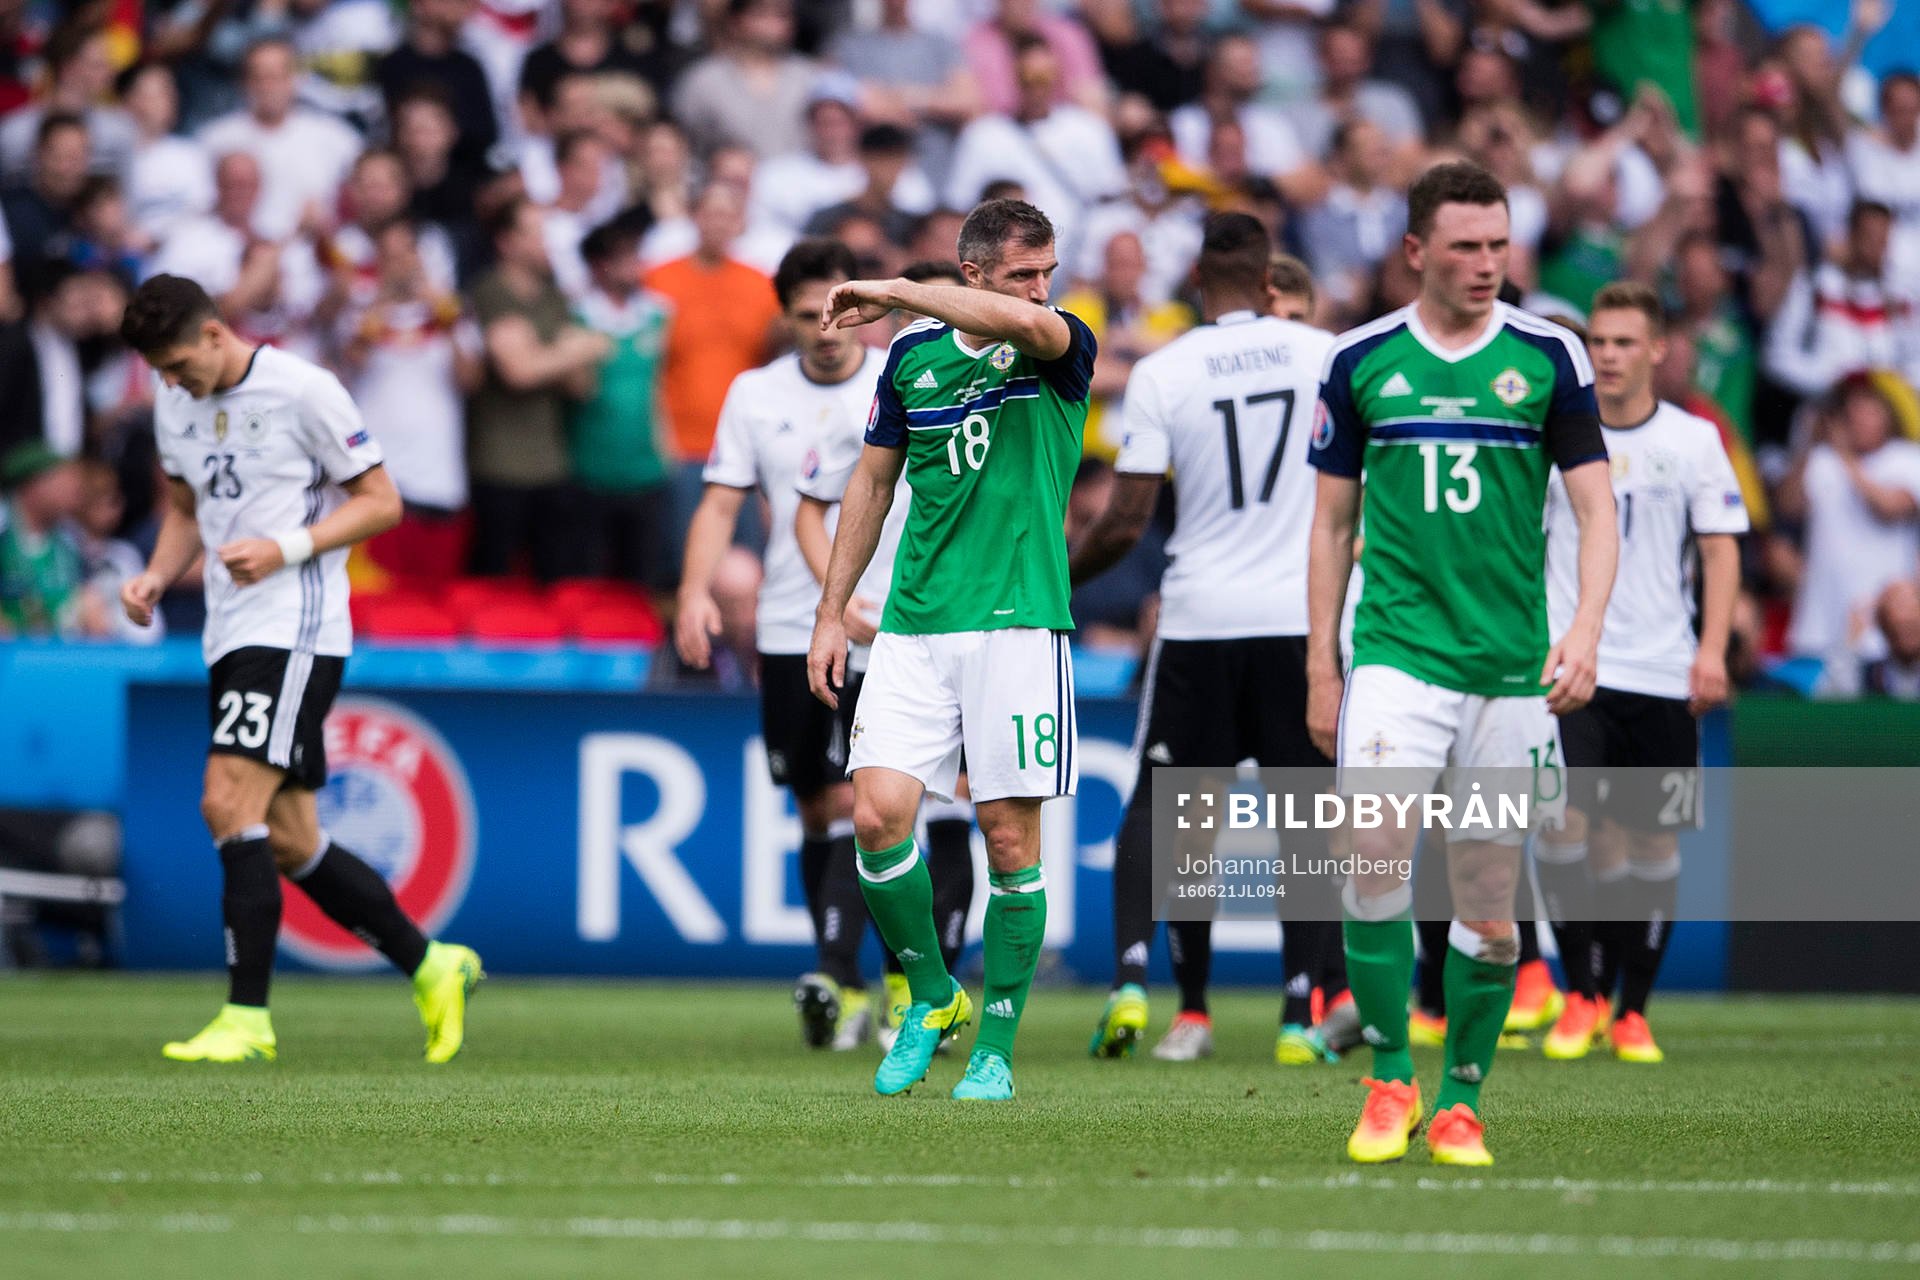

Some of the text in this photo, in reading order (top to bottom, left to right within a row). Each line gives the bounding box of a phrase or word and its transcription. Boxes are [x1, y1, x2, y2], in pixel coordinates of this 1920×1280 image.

[1206, 344, 1292, 377] BOATENG
[947, 414, 990, 475] 18
[1213, 389, 1295, 510] 17
[204, 454, 242, 499] 23
[1419, 443, 1482, 513] 13
[213, 690, 272, 748] 23
[1012, 713, 1057, 770] 18
